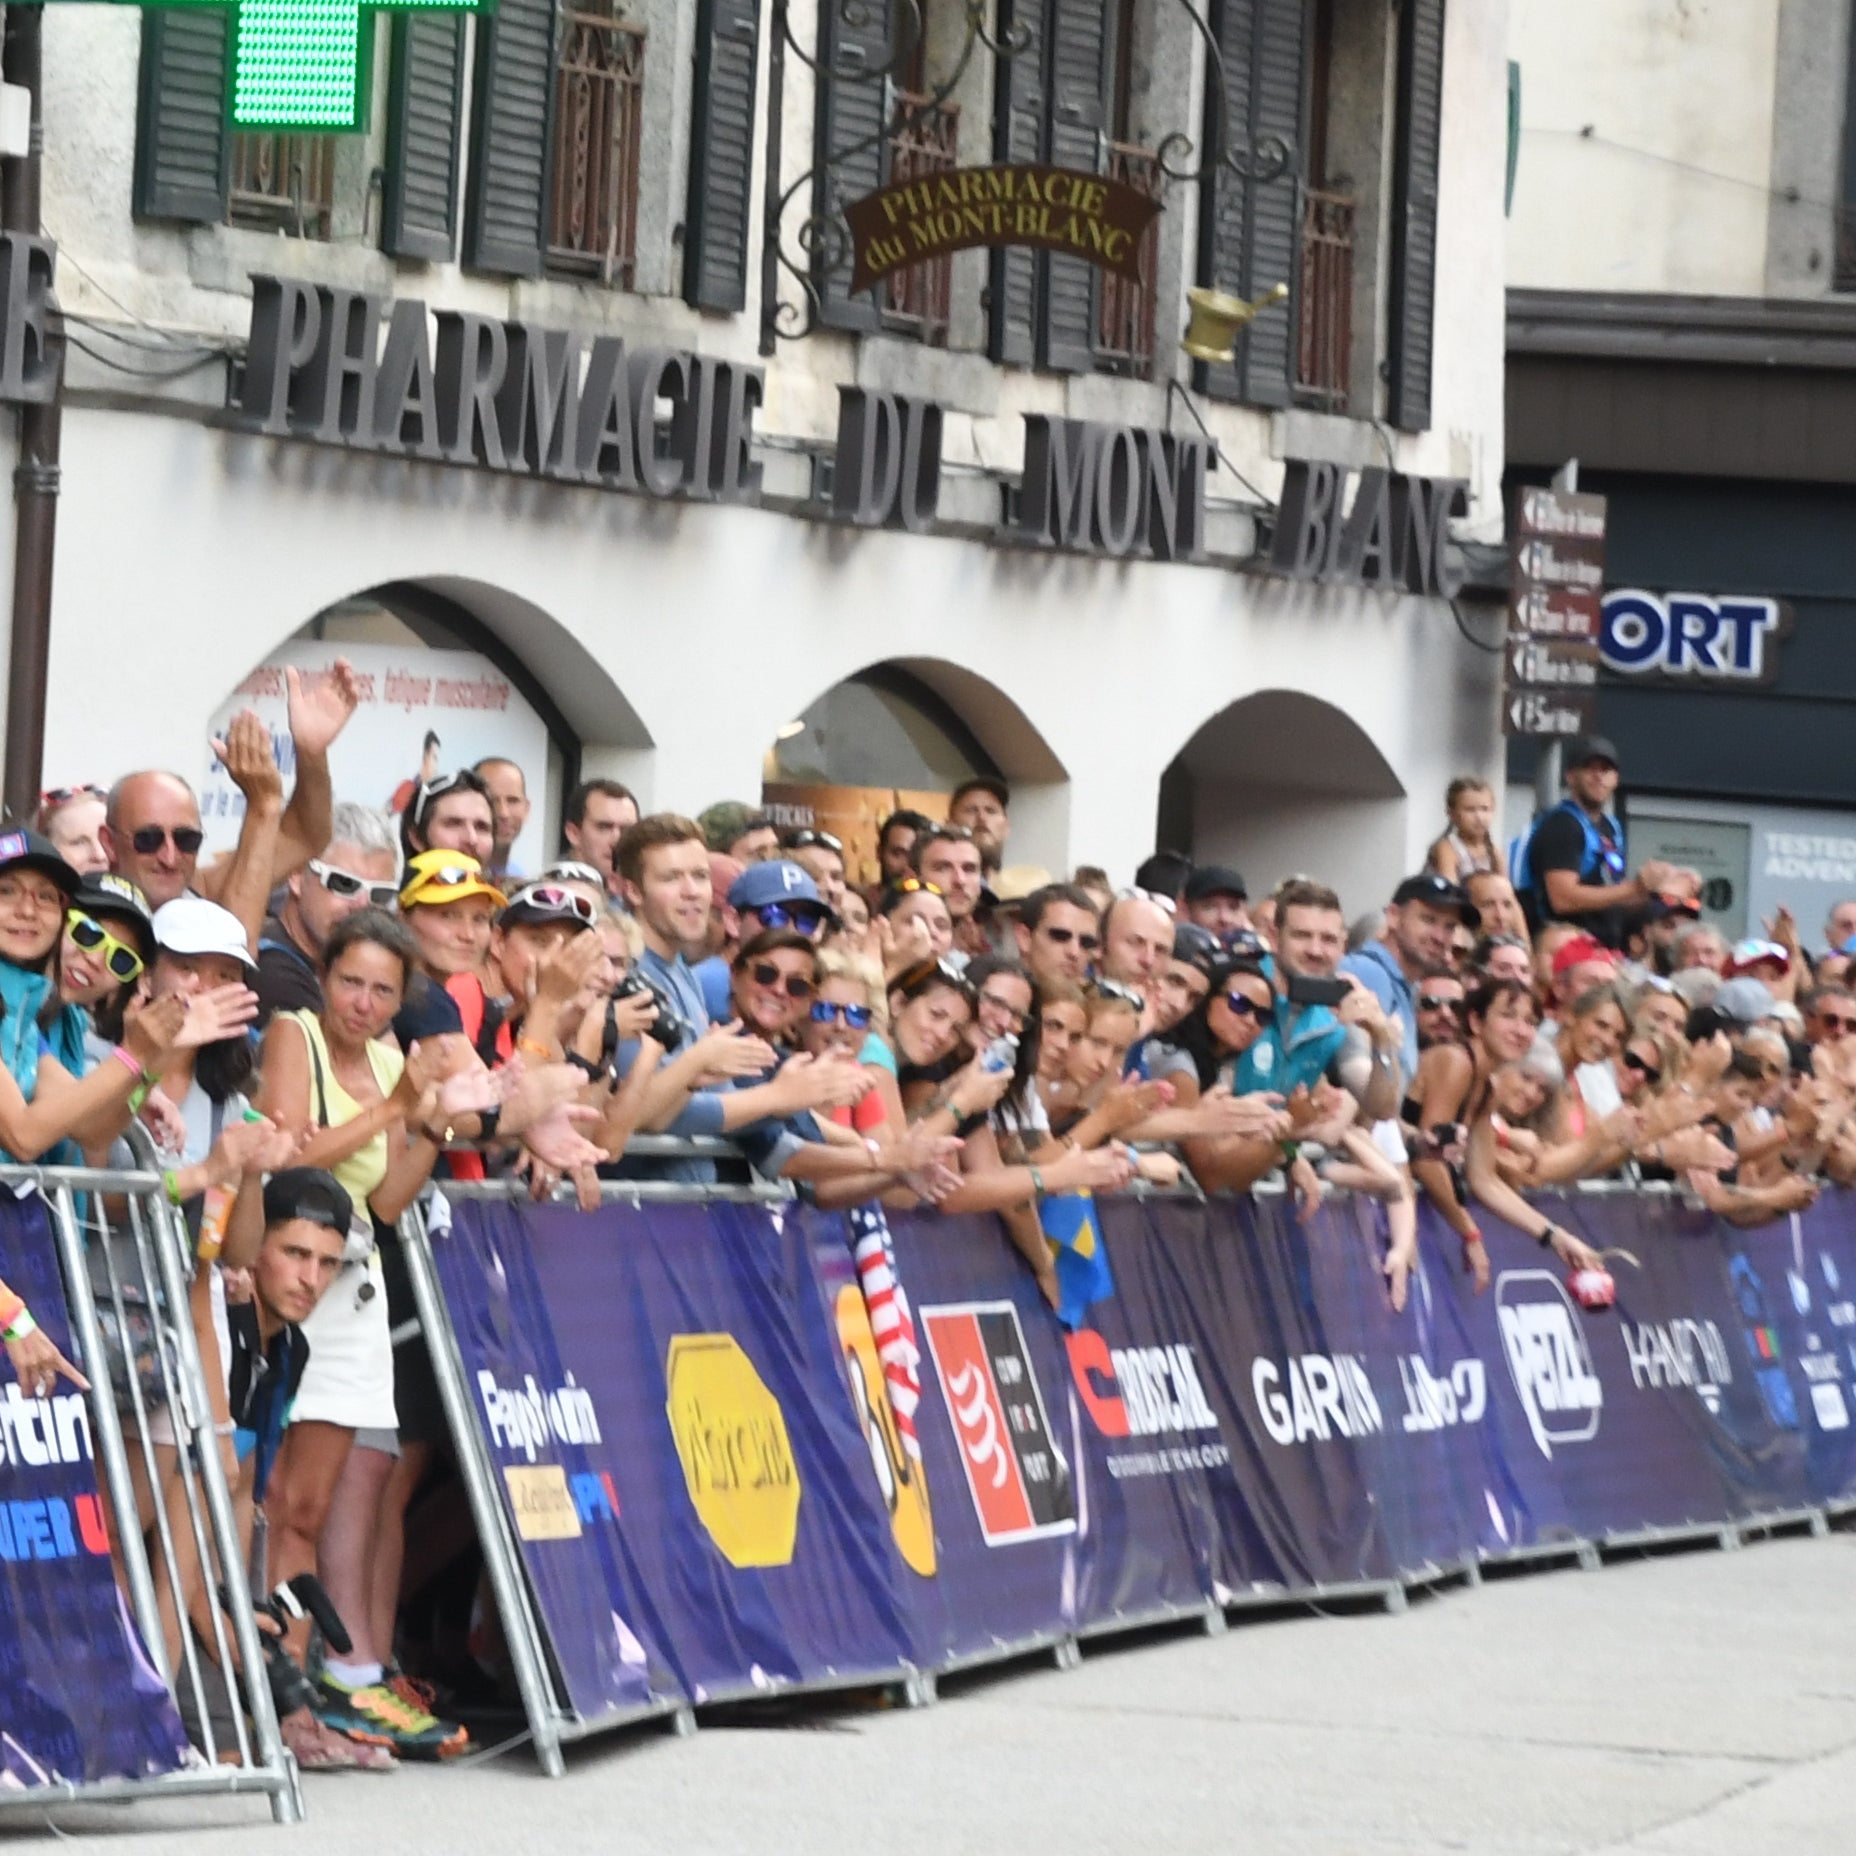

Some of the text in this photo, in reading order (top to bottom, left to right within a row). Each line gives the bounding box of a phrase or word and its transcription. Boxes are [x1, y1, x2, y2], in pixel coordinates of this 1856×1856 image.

[880, 168, 1109, 225] PHARMACIE
[865, 202, 1133, 275] du MONT-BLANC
[240, 270, 1472, 599] PHARMACIE DU MONT BLANC
